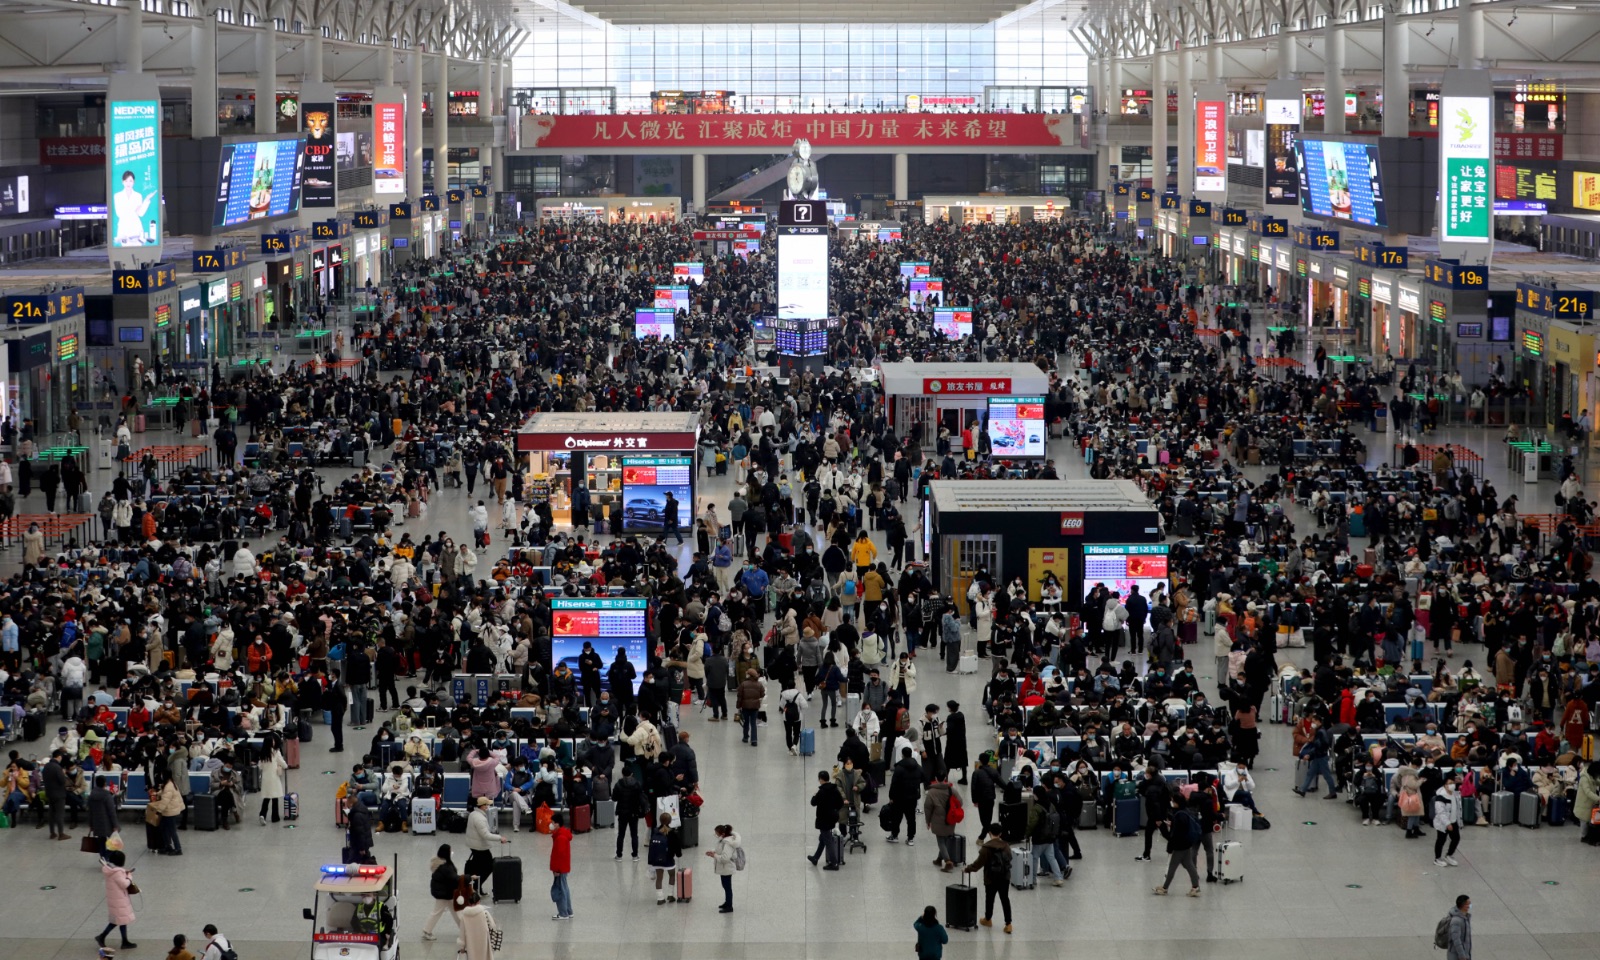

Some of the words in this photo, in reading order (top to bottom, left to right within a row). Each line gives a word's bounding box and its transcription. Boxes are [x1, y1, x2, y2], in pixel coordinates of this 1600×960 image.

[114, 105, 155, 116] NEDFON
[592, 121, 685, 140] 凡人微光
[698, 120, 792, 140] 汇聚成炬
[806, 119, 900, 140] 中国力量
[913, 119, 1008, 140] 未来希望
[382, 121, 396, 165] 浪鲸卫浴
[1204, 118, 1218, 163] 浪鲸卫浴
[305, 145, 330, 155] CBD
[474, 188, 483, 196] 3A
[1473, 165, 1486, 208] 兔宝宝
[450, 194, 460, 202] 5A
[1460, 165, 1473, 223] 让家更好
[424, 199, 434, 208] 7A
[395, 206, 406, 216] 9A
[358, 215, 374, 225] 11A
[1226, 213, 1243, 223] 11B
[316, 226, 334, 236] 13A
[1266, 223, 1285, 233] 13B
[265, 238, 285, 249] 15A
[1315, 235, 1335, 246] 15B
[197, 255, 220, 268] 17A
[1381, 251, 1403, 264] 17B
[118, 275, 142, 289] 19A
[1459, 271, 1483, 285] 19B
[13, 301, 42, 318] 21A
[1558, 297, 1588, 313] 21B
[946, 382, 984, 392] 旅友书屋
[613, 437, 648, 448] 外交官
[1062, 518, 1083, 528] LEGO
[1089, 546, 1125, 554] Hisense
[557, 600, 597, 609] Hisense
[1568, 709, 1583, 725] A
